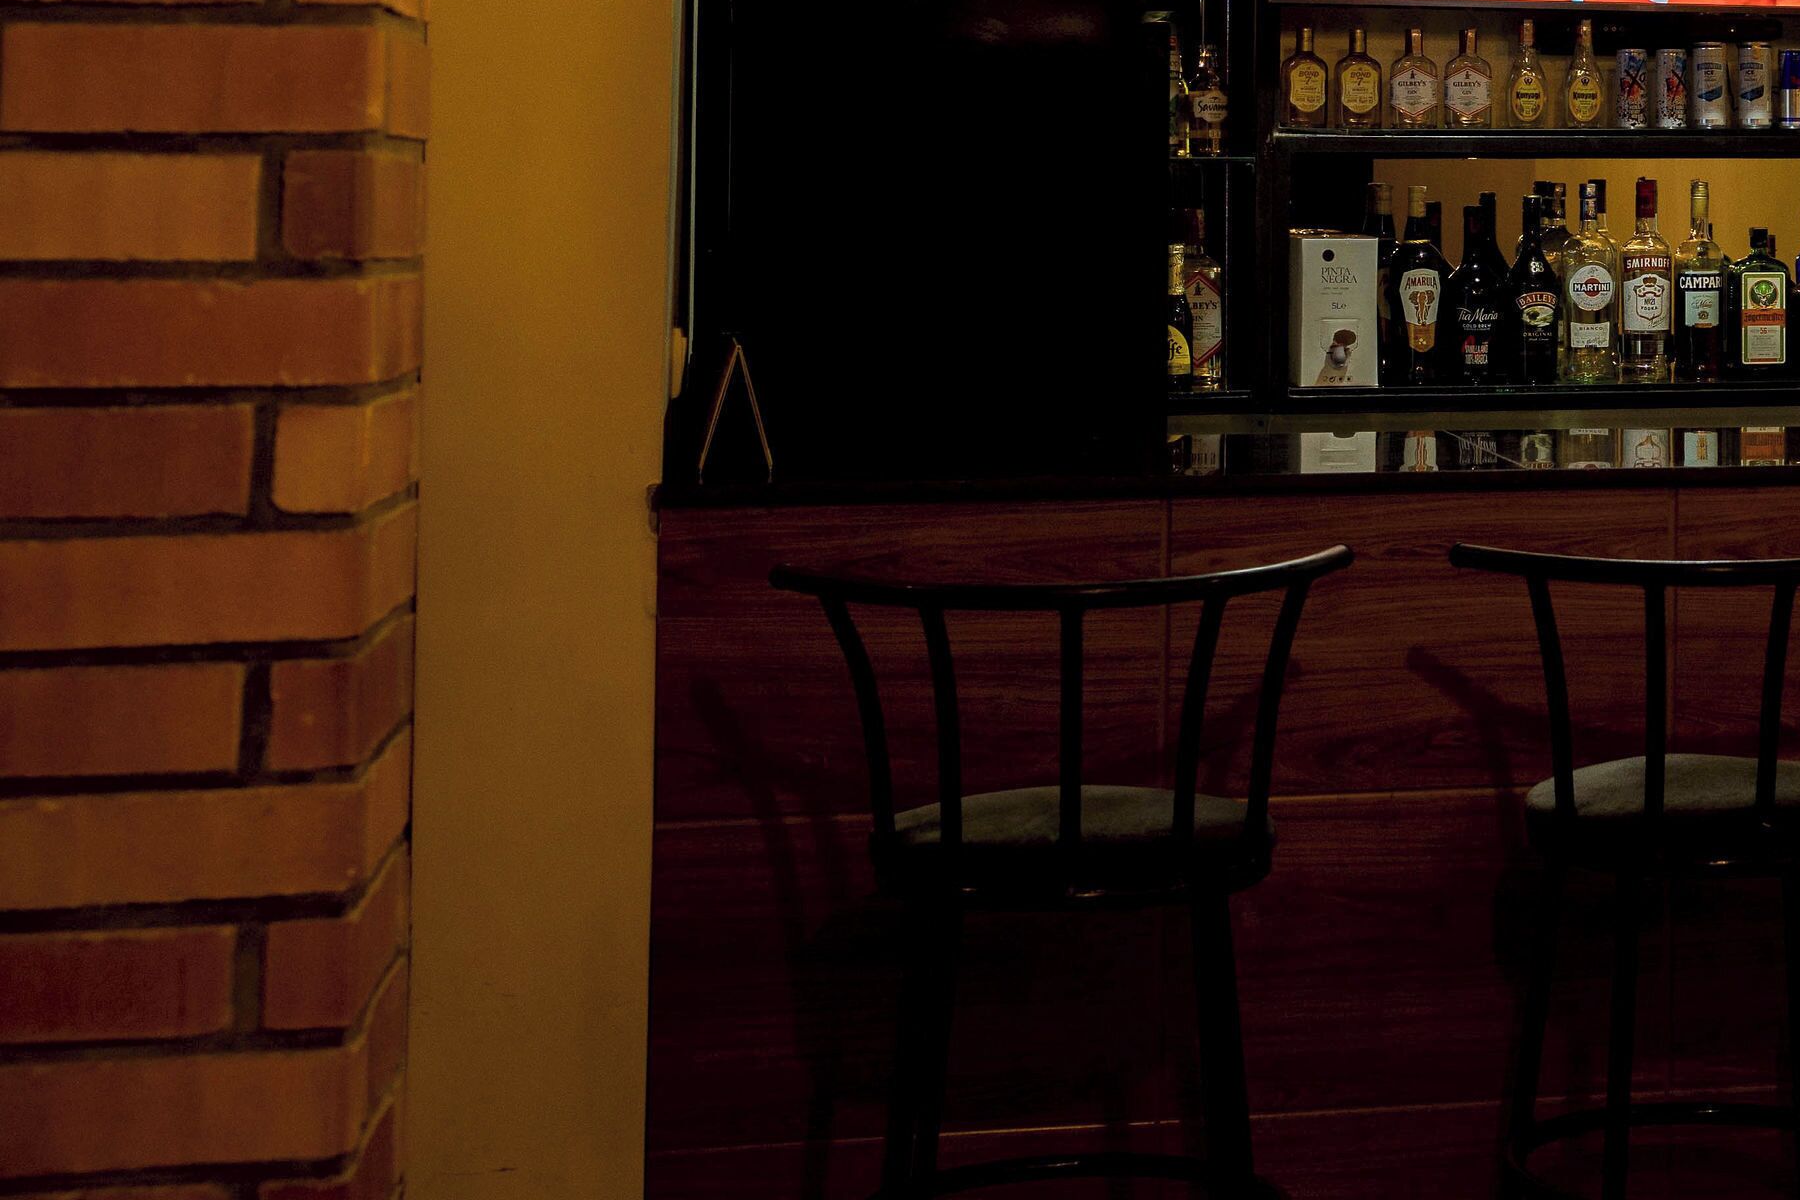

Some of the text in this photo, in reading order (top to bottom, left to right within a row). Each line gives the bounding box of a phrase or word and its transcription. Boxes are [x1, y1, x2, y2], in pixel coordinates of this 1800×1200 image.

[1298, 70, 1320, 78] BOND
[1321, 266, 1351, 276] PINTA
[1320, 275, 1358, 284] NEGRA
[1404, 276, 1438, 290] AMARULA
[1574, 283, 1610, 292] MARTINI
[1518, 293, 1557, 307] BAILEYS
[1456, 306, 1499, 323] Tia Maria
